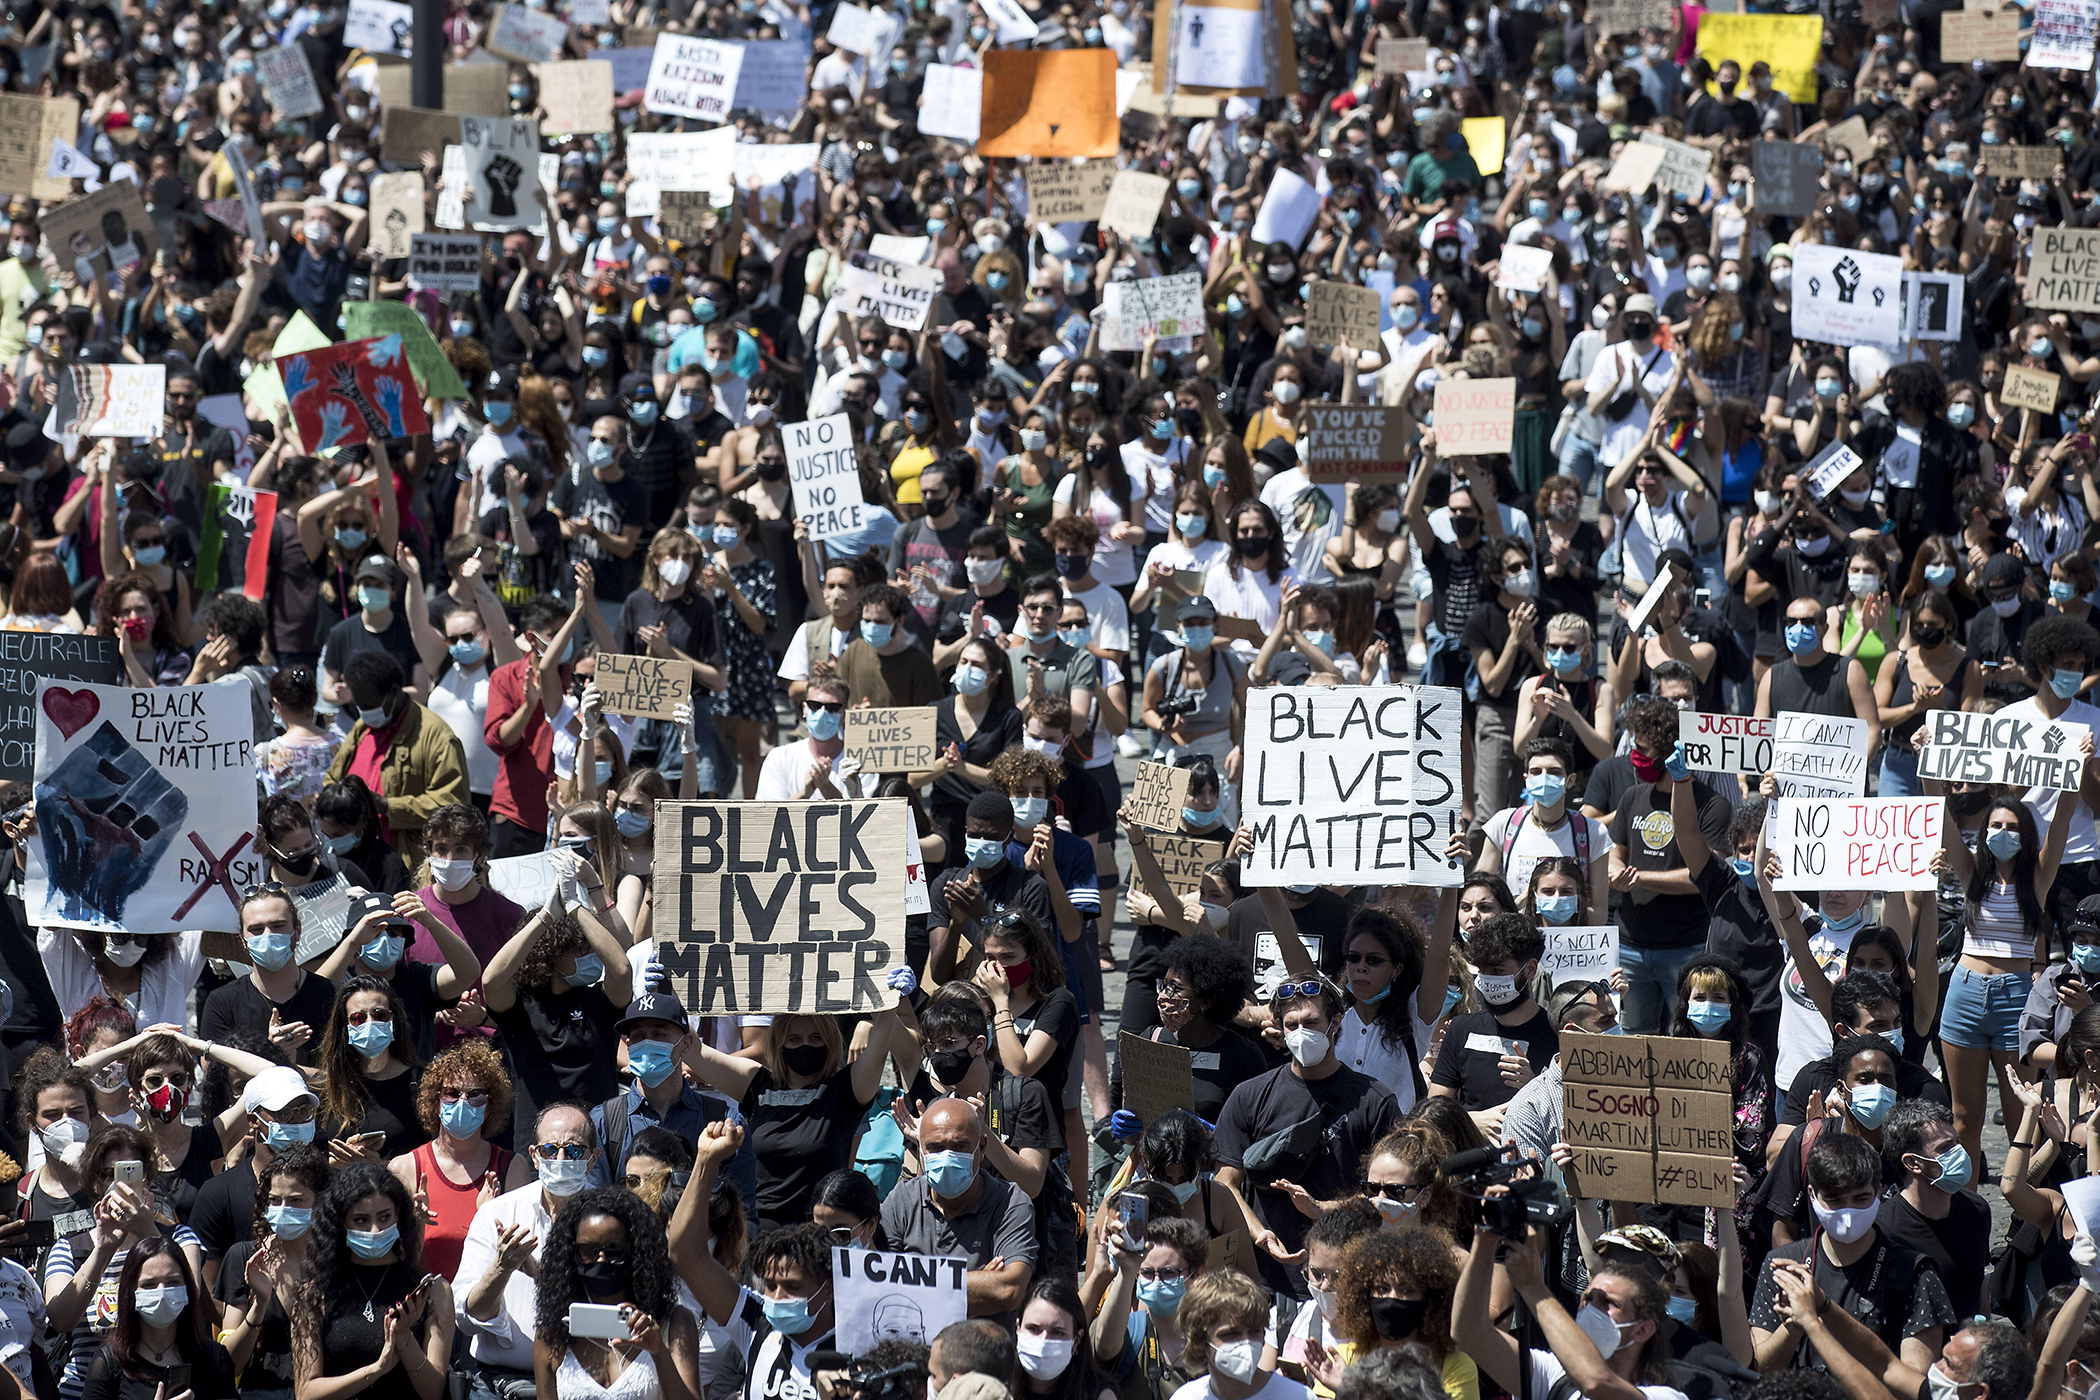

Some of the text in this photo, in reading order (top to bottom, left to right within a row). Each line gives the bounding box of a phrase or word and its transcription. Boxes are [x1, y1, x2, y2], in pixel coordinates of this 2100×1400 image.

[464, 117, 533, 150] BLM
[2045, 233, 2100, 257] BLAC
[2051, 256, 2100, 279] LIVE
[882, 282, 929, 303] LIVES
[1312, 285, 1368, 305] BLACK
[2036, 277, 2100, 306] MATTE
[857, 295, 920, 323] MATTER
[1310, 303, 1378, 327] LIVES
[1308, 324, 1365, 341] MATTER
[1437, 390, 1513, 414] NO JUSTICE
[1311, 408, 1386, 429] YOU'VE
[796, 422, 834, 447] NO
[1310, 428, 1383, 447] FUCKED
[1437, 420, 1513, 444] NO PEACE
[790, 447, 859, 482] JUSTICE
[808, 486, 836, 508] NO
[802, 505, 861, 534] PEACE
[597, 653, 667, 678] BLACK
[624, 675, 685, 698] LIVES
[131, 690, 206, 719] BLACK
[600, 690, 663, 713] MATTER
[849, 710, 899, 726] BLACK
[1270, 692, 1443, 744] BLACK
[1698, 714, 1773, 737] JUSTICE
[1778, 716, 1856, 746] I CAN'T
[1933, 711, 2034, 751] BLACK
[136, 719, 209, 744] LIVES
[868, 726, 912, 744] LIVES
[159, 739, 254, 771] MATTER
[846, 744, 932, 769] MATTER
[1684, 735, 1775, 775] FOR FLO
[1774, 749, 1835, 775] BREATH
[1136, 761, 1176, 787] BLACK
[1257, 749, 1455, 806] LIVES
[1918, 747, 2082, 791] LIVES MATTER
[1138, 782, 1173, 806] LIVES
[1131, 801, 1176, 828] MATTER
[1631, 814, 1675, 836] Hard Ro
[1794, 802, 1940, 840] NO JUSTICE
[681, 802, 879, 874] BLACK
[1149, 836, 1205, 859] LACK
[1246, 809, 1458, 872] MATTER!
[1161, 857, 1204, 878] LIVE
[1793, 841, 1927, 877] NO PEACE
[678, 871, 878, 943] LIVES
[1549, 932, 1610, 950] IS NOT A
[1545, 952, 1608, 970] SYSTEMIC
[658, 939, 892, 1013] MATTER
[1662, 1058, 1732, 1086] ANCORA
[1586, 1088, 1660, 1118] SOGNO
[1657, 1125, 1731, 1150] LUTHER
[1657, 1164, 1729, 1193] #BLM
[839, 1249, 968, 1291] I CAN'T
[1867, 1263, 1882, 1292] DIGITAL
[762, 1368, 818, 1400] Jee
